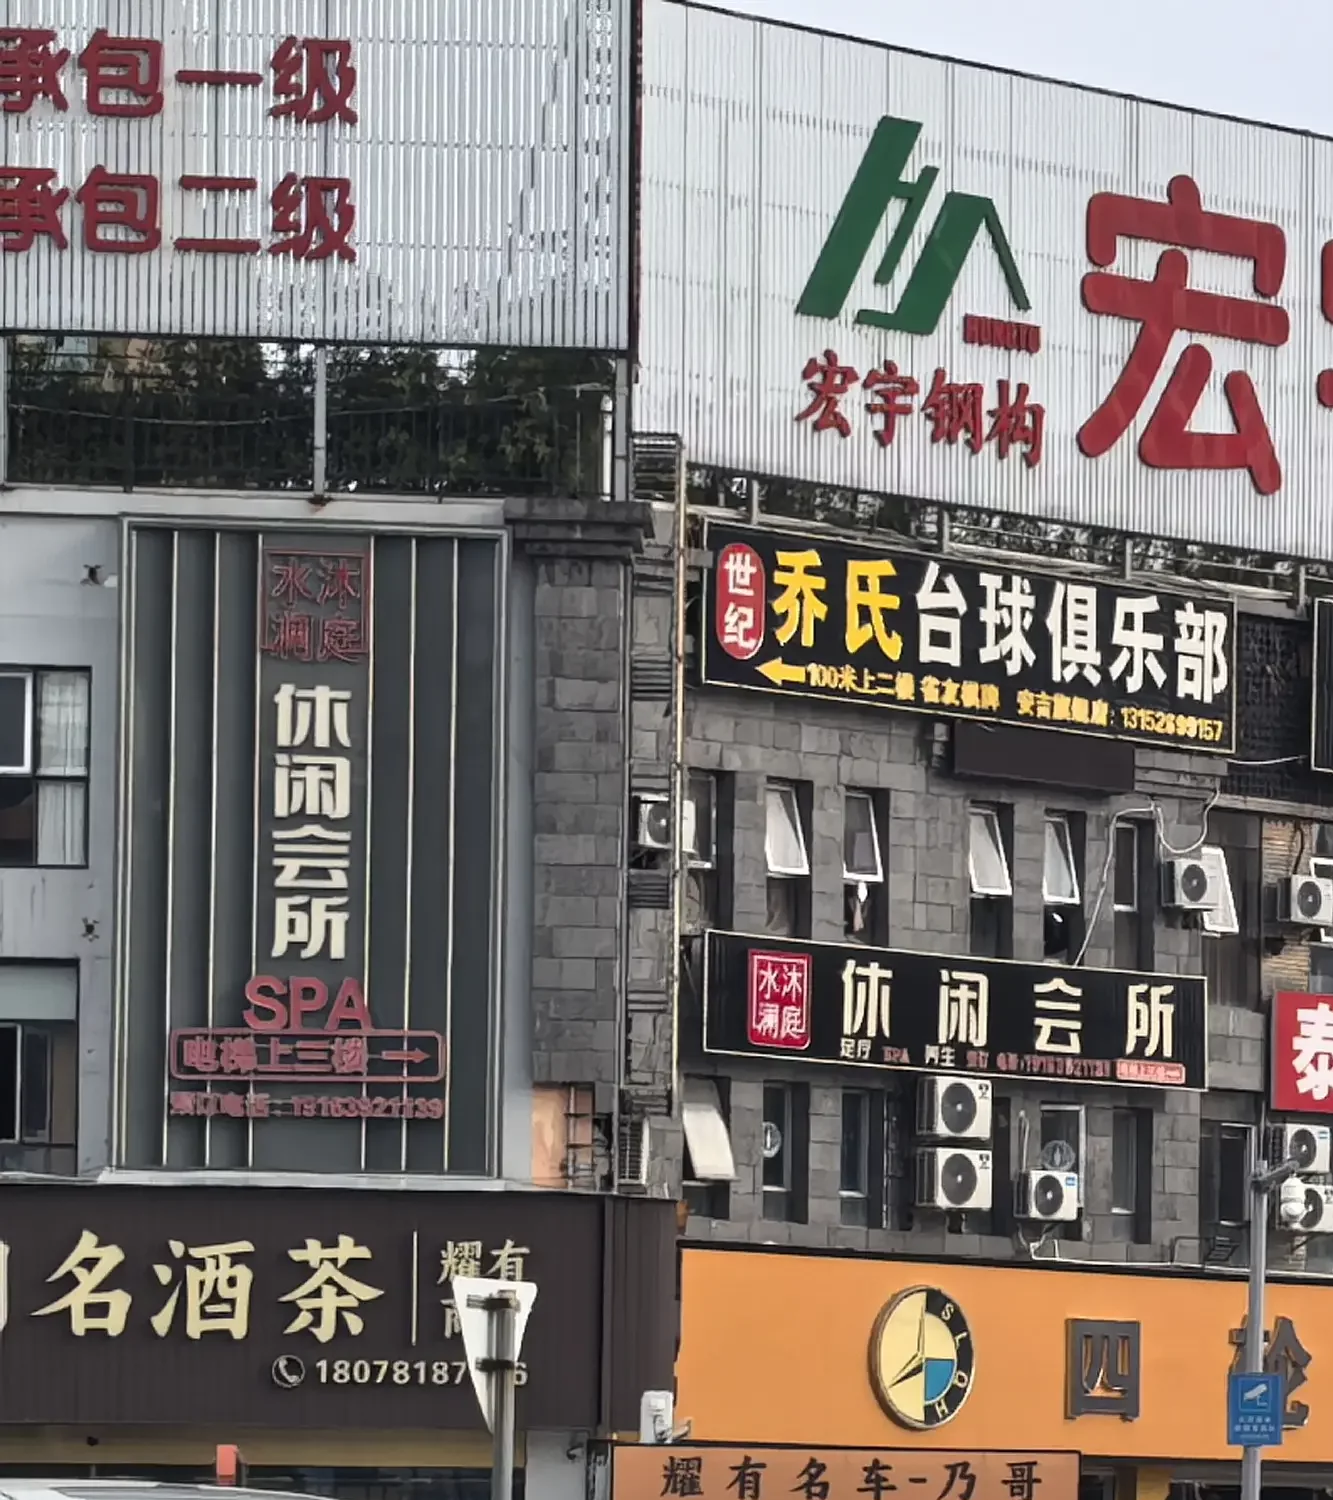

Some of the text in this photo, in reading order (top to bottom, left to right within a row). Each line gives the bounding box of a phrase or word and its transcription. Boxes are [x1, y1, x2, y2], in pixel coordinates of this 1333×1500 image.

[0, 27, 358, 126] 承包一级
[0, 165, 357, 263] 承包二级
[795, 349, 1045, 469] 宏宇钢构
[723, 552, 757, 649] 世纪
[773, 549, 1229, 703] 乔氏台球俱乐部
[271, 683, 352, 960] 休闲会所
[243, 976, 372, 1031] SPA
[842, 959, 1175, 1058] 休闲会所
[0, 1228, 384, 1344] 名酒茶
[316, 1359, 528, 1386] 180781876
